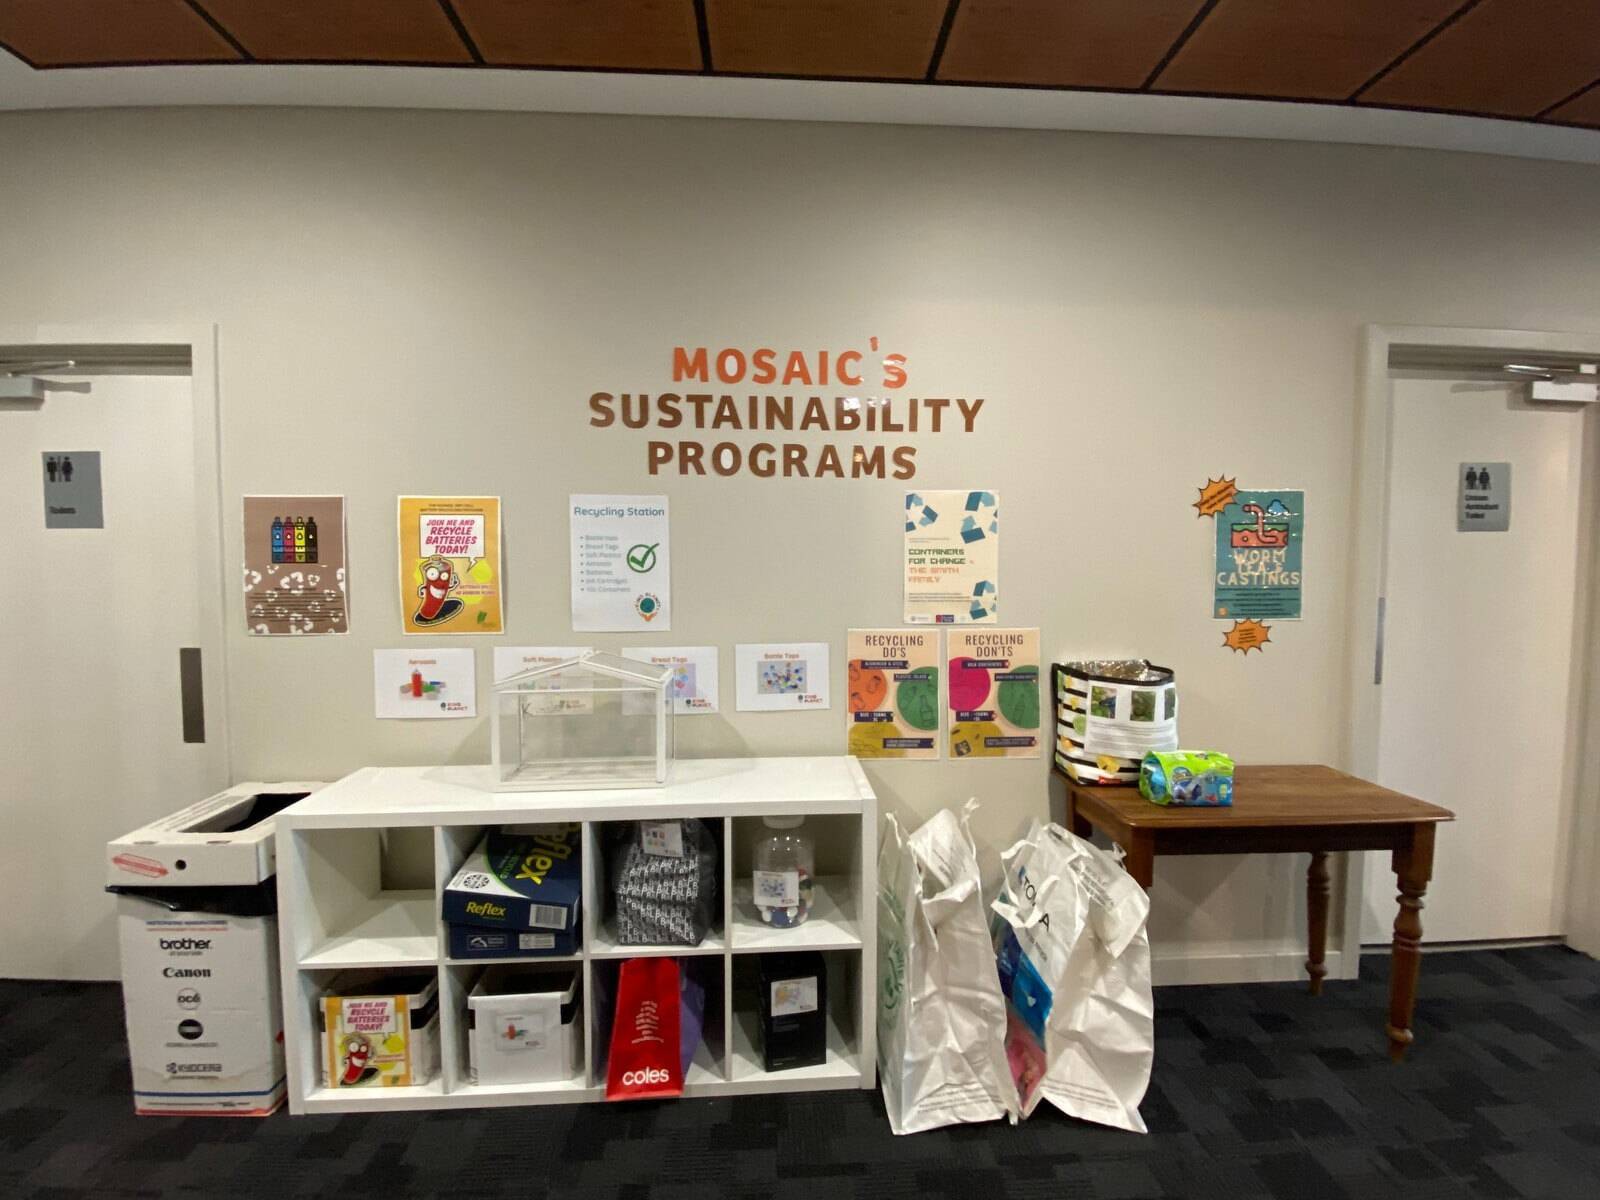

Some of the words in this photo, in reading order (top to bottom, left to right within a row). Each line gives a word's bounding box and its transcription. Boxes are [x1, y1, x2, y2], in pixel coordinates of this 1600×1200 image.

[672, 336, 908, 389] MOSAIC'S
[588, 392, 985, 433] SUSTAINABILITY
[648, 441, 917, 480] PROGRAMS
[574, 506, 624, 518] Recycling
[627, 507, 665, 517] Station
[430, 526, 473, 535] RECYCLE
[425, 536, 478, 545] BATTERIES
[435, 545, 469, 554] TODAY!
[908, 548, 965, 556] CONTAINERS
[1233, 549, 1286, 563] WORM
[1216, 571, 1301, 586] CASTINGS
[865, 635, 924, 647] RECYCLING
[965, 634, 1024, 646] RECYCLING
[882, 647, 906, 658] DO'S
[976, 646, 1013, 657] DON'TS
[466, 901, 507, 917] Reflex
[160, 938, 211, 950] brother
[163, 967, 211, 978] Canon
[622, 1066, 670, 1086] coles
